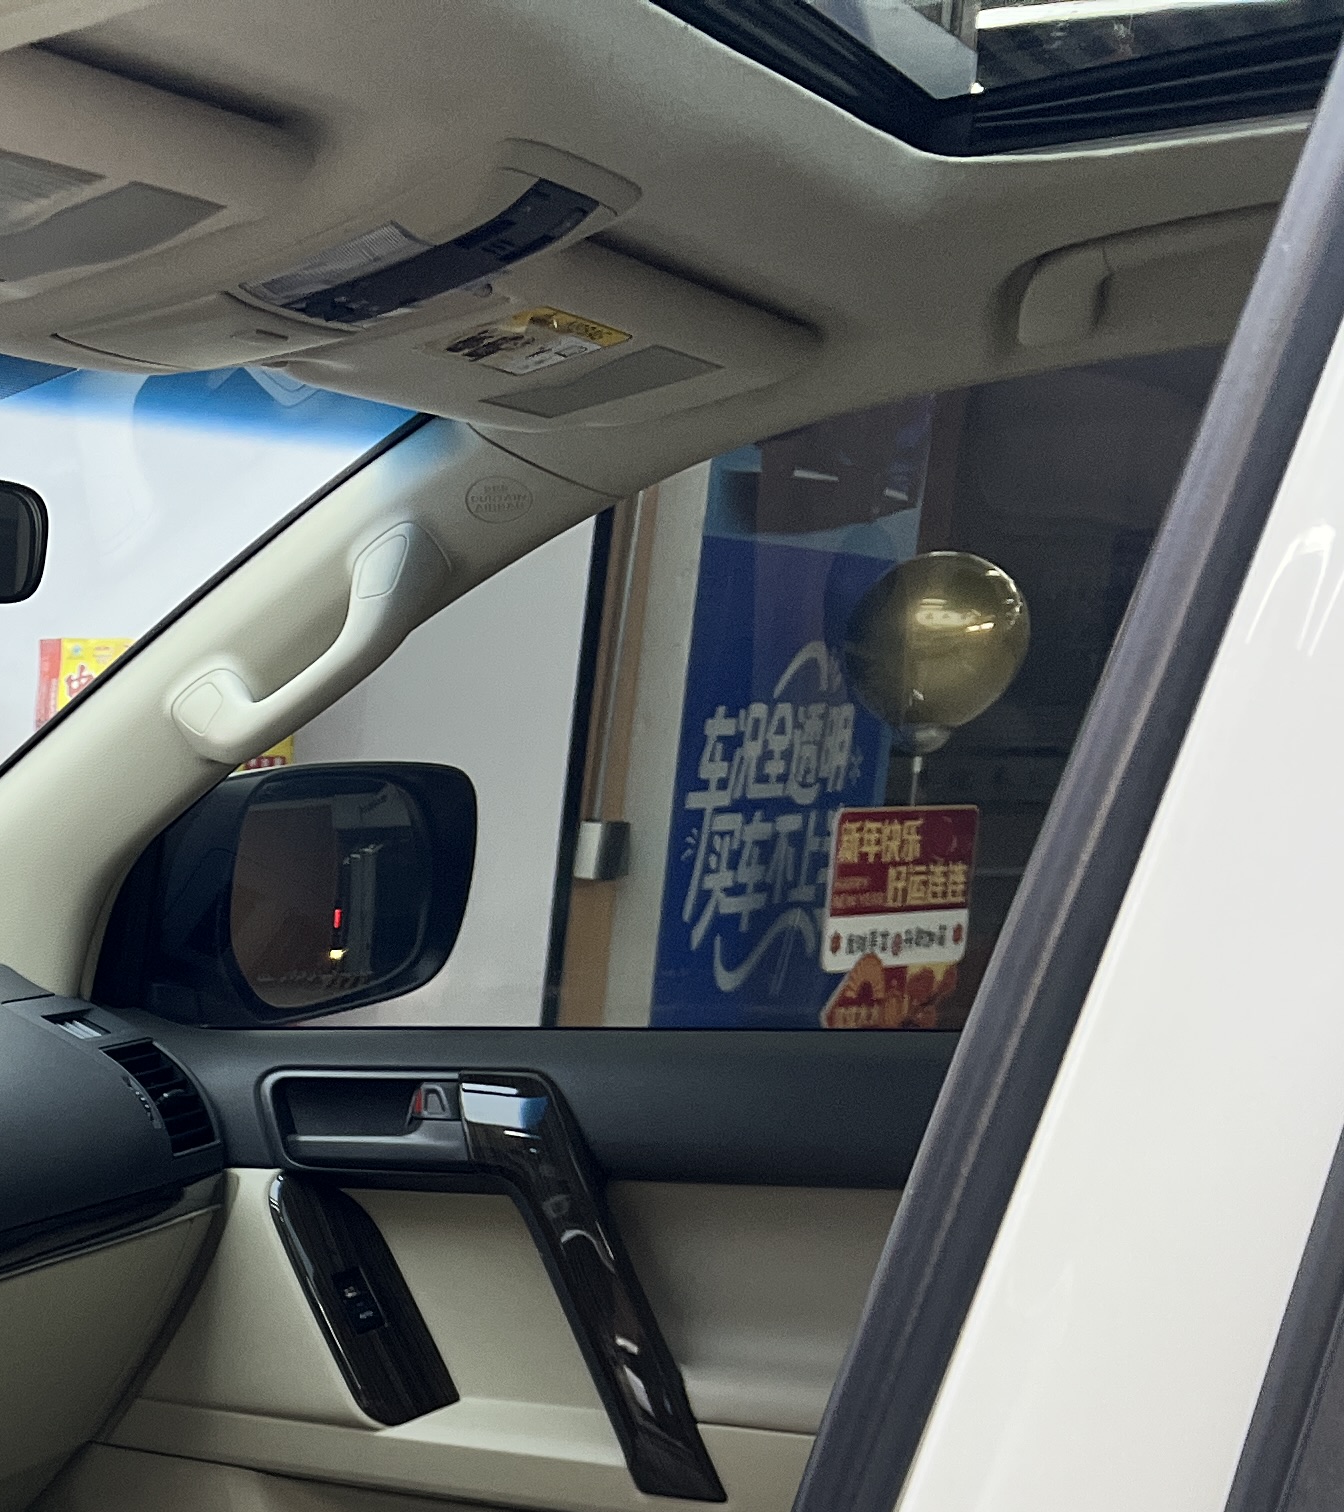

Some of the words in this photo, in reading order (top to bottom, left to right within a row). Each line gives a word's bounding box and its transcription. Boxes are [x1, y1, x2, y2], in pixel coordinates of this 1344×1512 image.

[685, 702, 856, 811] 车况全透明
[837, 818, 924, 864] 新年快乐
